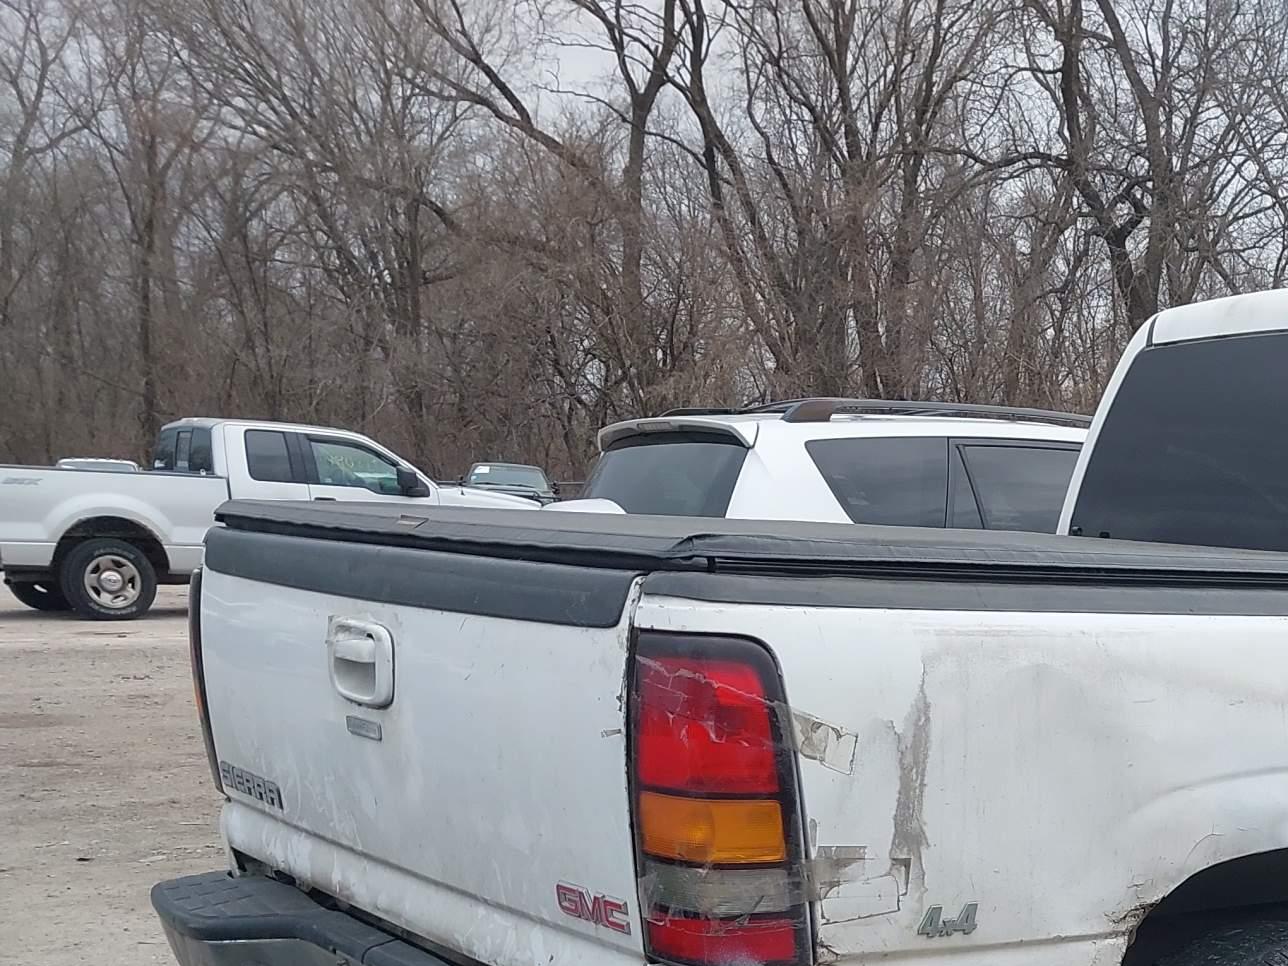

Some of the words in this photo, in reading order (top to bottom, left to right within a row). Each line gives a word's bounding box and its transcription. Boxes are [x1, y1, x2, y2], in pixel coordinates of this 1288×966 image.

[220, 761, 284, 810] SIERRA
[555, 880, 631, 936] GMC
[917, 901, 979, 938] 4x4
